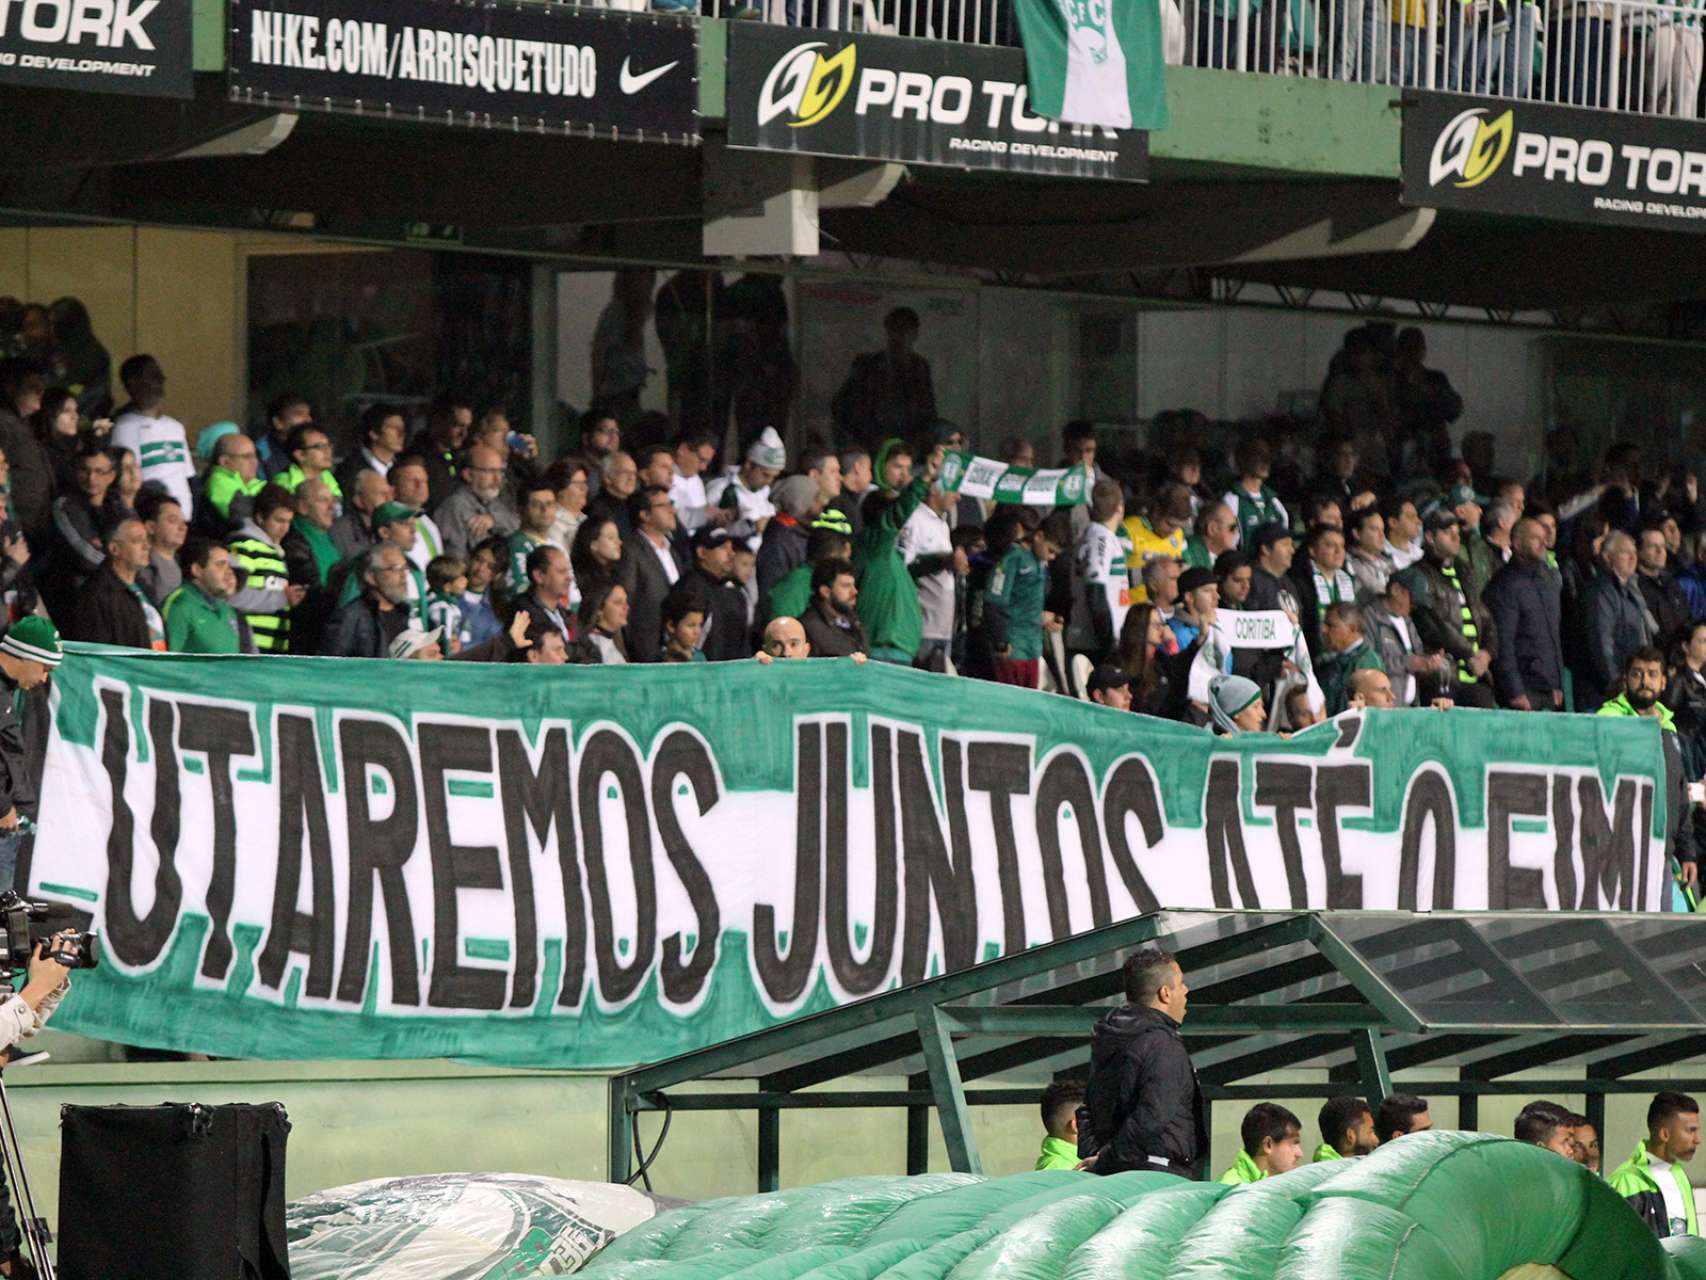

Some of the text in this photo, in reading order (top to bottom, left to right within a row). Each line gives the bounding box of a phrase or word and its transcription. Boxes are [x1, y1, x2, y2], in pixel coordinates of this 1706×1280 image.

[19, 54, 156, 77] DEVELOPMENT
[250, 9, 597, 98] NIKE.COM/ARRISQUETUDO
[855, 68, 973, 125] PRO
[949, 138, 1119, 163] RACING DEVELOPMENT
[1513, 132, 1614, 187] PRO
[1594, 197, 1644, 213] RACING
[1235, 617, 1277, 640] CORITIBA
[753, 722, 1164, 1001] JUNTOS
